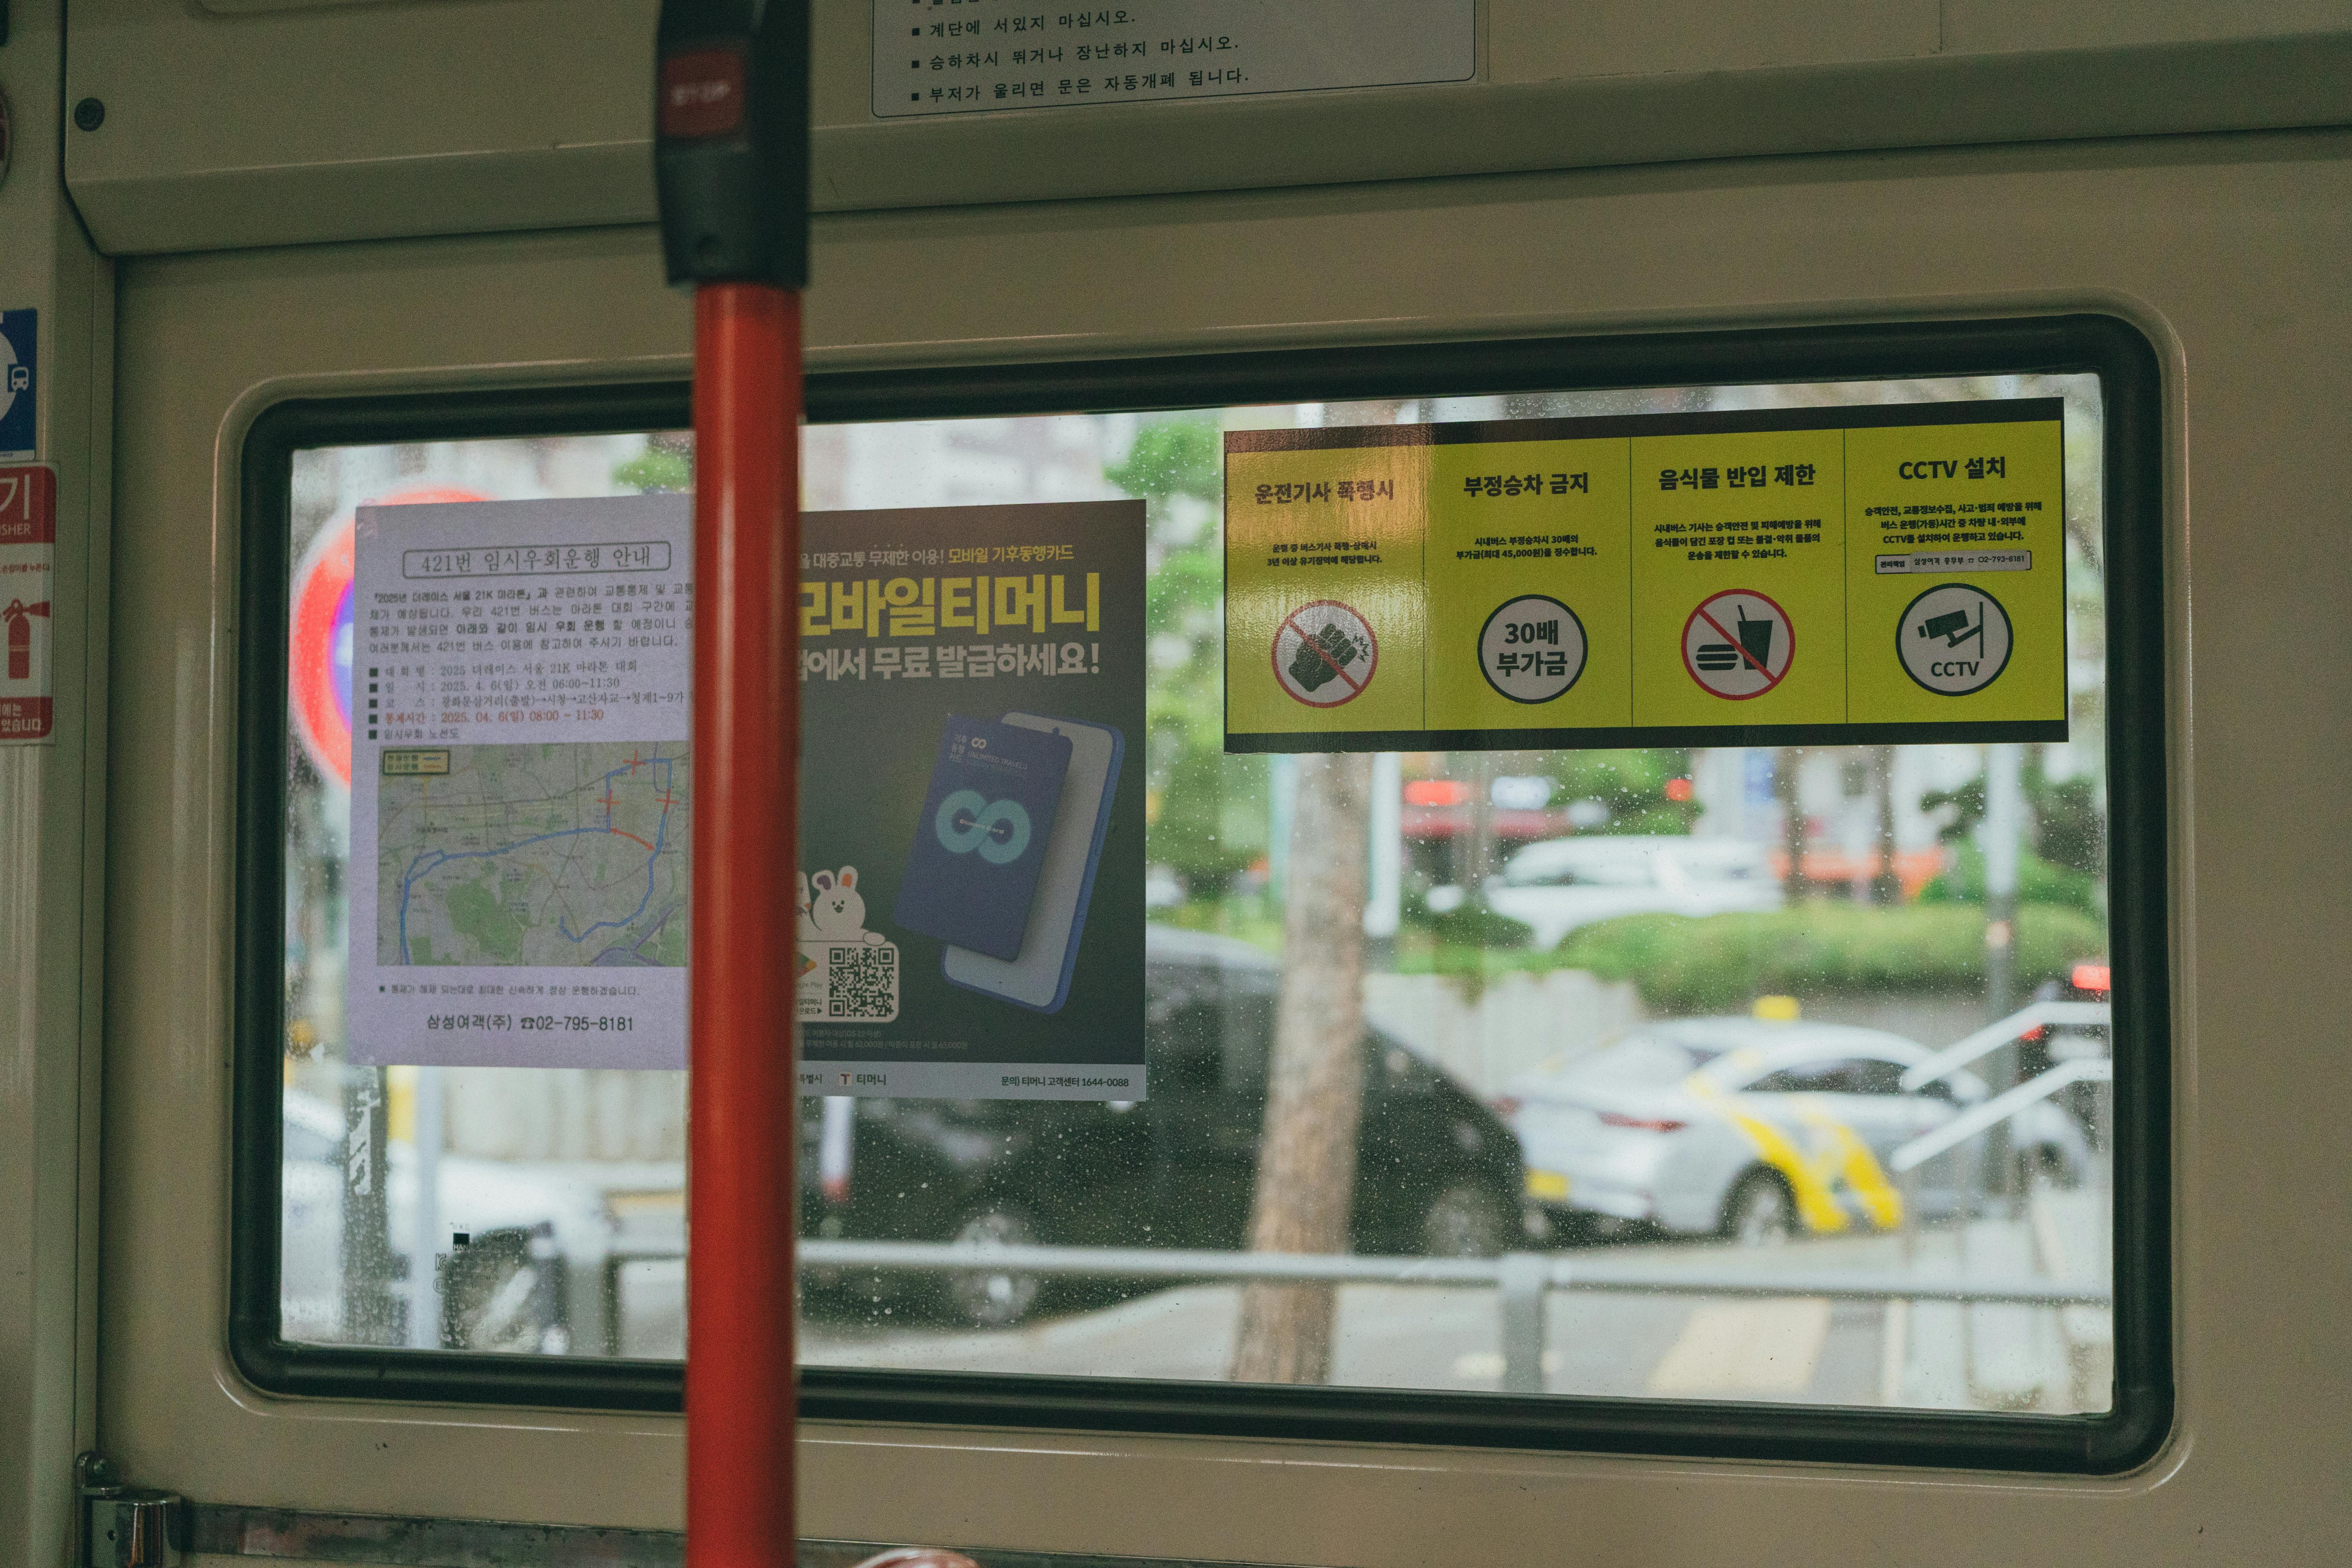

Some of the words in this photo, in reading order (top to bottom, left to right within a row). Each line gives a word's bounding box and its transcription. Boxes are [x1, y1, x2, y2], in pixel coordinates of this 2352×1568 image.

[929, 19, 980, 37] 계단에
[993, 15, 1045, 33] 서있지
[1059, 10, 1135, 29] 마십시오.
[930, 51, 998, 71] 승하차시
[1013, 46, 1063, 65] 뛰거나
[1076, 40, 1146, 60] 장난하지
[1160, 36, 1239, 54] 마십시오.
[929, 85, 980, 103] 부저가
[993, 80, 1044, 99] 울리면
[1058, 78, 1091, 95] 문은
[1104, 72, 1175, 91] 자동개폐
[1189, 67, 1249, 86] 됩니다.
[1898, 460, 1958, 480] CCTV
[1964, 456, 2006, 479] 설치
[1464, 474, 1543, 497] 부정승차
[1549, 472, 1588, 494] 금지
[1659, 468, 1719, 490] 음식물
[1727, 465, 1766, 488] 반입
[1774, 464, 1816, 486] 제한
[1255, 481, 1331, 505] 운전기사
[1337, 479, 1394, 502] 폭행시
[1865, 506, 1901, 516] 승객안전,
[1903, 505, 1956, 515] 교통정보수집,
[1997, 502, 2022, 512] 예방을
[2025, 501, 2042, 511] 위해
[1654, 523, 1687, 534] 시내버스
[1689, 523, 1713, 533] 기사는
[1715, 522, 1748, 532] 승객안전
[1751, 521, 1759, 530] 및
[1761, 519, 1802, 530] 피해예방을
[1805, 519, 1821, 528] 위해
[1881, 521, 1898, 530] 버스
[1900, 519, 1956, 529] 운행(가동)시간
[1958, 519, 1966, 528] 중
[1968, 517, 1985, 527] 차량
[1475, 537, 1507, 547] 시내버스
[1509, 535, 1548, 545] 부정승차시
[1552, 534, 1579, 544] 30배의
[1655, 537, 1687, 548] 음식물이
[1690, 537, 1706, 546] 담긴
[1708, 536, 1724, 545] 포장
[1727, 536, 1735, 545] 컵
[1737, 535, 1754, 544] 또는
[1795, 533, 1820, 543] 물품의
[1883, 534, 1915, 543] CCTV를
[1917, 533, 1950, 543] 설치하여
[1953, 532, 1986, 543] 운행하고
[1988, 531, 2024, 541] 있습니다.
[1273, 543, 1288, 553] 운행
[1290, 543, 1298, 553] 중
[1300, 543, 1332, 552] 버스기사
[1456, 549, 1500, 560] 부가금(최대
[1502, 548, 1552, 559] 45,000원)을
[1555, 546, 1597, 557] 징수합니다.
[1688, 551, 1712, 561] 운송을
[1715, 550, 1739, 560] 제한할
[1741, 550, 1749, 559] 수
[1752, 549, 1787, 558] 있습니다.
[421, 552, 471, 573] 421번
[483, 547, 600, 572] 임시우회운행
[613, 545, 650, 567] 안내
[813, 552, 866, 569] 대중교통
[869, 550, 909, 567] 무제한
[911, 549, 945, 566] 이용!
[948, 547, 989, 564] 모바일
[992, 544, 1075, 563] 기후동행카드
[1267, 557, 1279, 566] 3년
[1282, 557, 1298, 566] 이상
[1300, 555, 1338, 566] 유기징역에
[1341, 553, 1382, 564] 해당됩니다.
[1914, 557, 1940, 566] 삼성여객
[1944, 556, 1964, 565] 총무부
[412, 591, 449, 603] 더레이스
[453, 590, 470, 602] 서울
[475, 590, 493, 601] 21K
[555, 586, 597, 599] 관련하여
[604, 584, 648, 597] 교통통제
[655, 583, 666, 595] 및
[397, 607, 454, 620] 예상됩니다.
[462, 606, 483, 618] 우리
[491, 606, 520, 617] 421번
[529, 604, 562, 616] 버스는
[571, 603, 602, 615] 마라톤
[612, 601, 633, 613] 대회
[642, 600, 675, 612] 구간에
[456, 623, 488, 635] 아래와
[497, 622, 517, 634] 같이
[526, 621, 546, 633] 임시
[556, 620, 576, 632] 우회
[584, 619, 605, 632] 운행
[631, 618, 675, 630] 예정이니
[1505, 619, 1558, 645] 30배
[369, 641, 431, 654] 여러분께서는
[437, 641, 465, 652] 421번
[473, 640, 494, 652] 버스
[501, 639, 533, 651] 이용에
[540, 638, 582, 650] 참고하여
[589, 637, 621, 648] 주시기
[628, 635, 678, 648] 바랍니다.
[441, 665, 466, 677] 2025
[472, 663, 516, 676] 더레이스
[524, 662, 544, 675] 서울
[550, 662, 571, 674] 21K
[576, 661, 608, 674] 마라톤
[615, 659, 637, 673] 대회
[872, 646, 932, 681] 무료
[936, 642, 1100, 679] 발급하세요!
[1497, 651, 1567, 678] 부가금
[1931, 661, 1980, 677] CCTV
[490, 679, 519, 692] 6(일)
[524, 678, 546, 691] 오전
[552, 677, 620, 690] 06:00~11:30
[386, 711, 425, 725] 통제시간
[498, 710, 524, 723] 6(일)
[529, 710, 559, 721] 08:00
[576, 709, 604, 721] 11:30
[429, 728, 459, 740] 노선도
[509, 985, 544, 995] 신속하게
[426, 1014, 512, 1032] 삼성여객(주)
[857, 1074, 887, 1086] 티머니
[1001, 1076, 1020, 1087] 문의)
[1022, 1076, 1046, 1087] 티머니
[1048, 1076, 1080, 1087] 고객센터
[1082, 1078, 1129, 1087] 1644-0088
